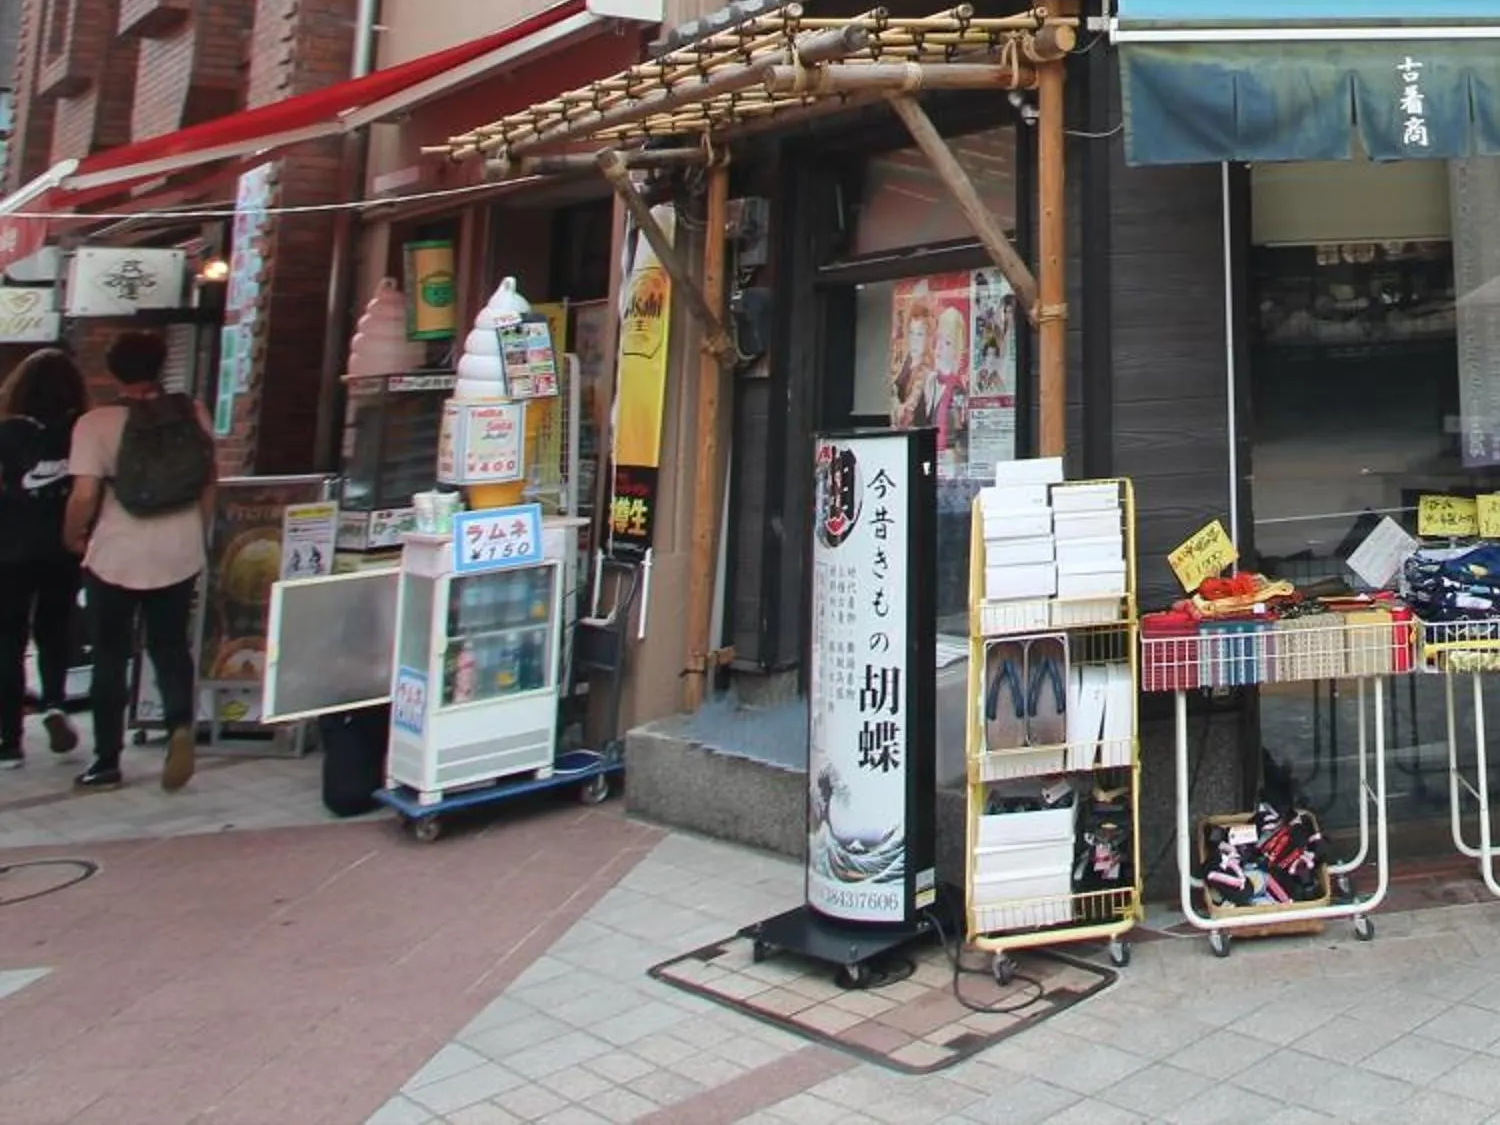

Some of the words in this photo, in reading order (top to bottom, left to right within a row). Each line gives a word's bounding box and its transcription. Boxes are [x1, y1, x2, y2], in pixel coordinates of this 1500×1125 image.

[1396, 56, 1429, 146] 古着商
[466, 518, 528, 543] ラムネ
[471, 542, 530, 561] ¥150
[867, 468, 897, 654] 今昔きもの
[858, 665, 901, 774] 胡蝶
